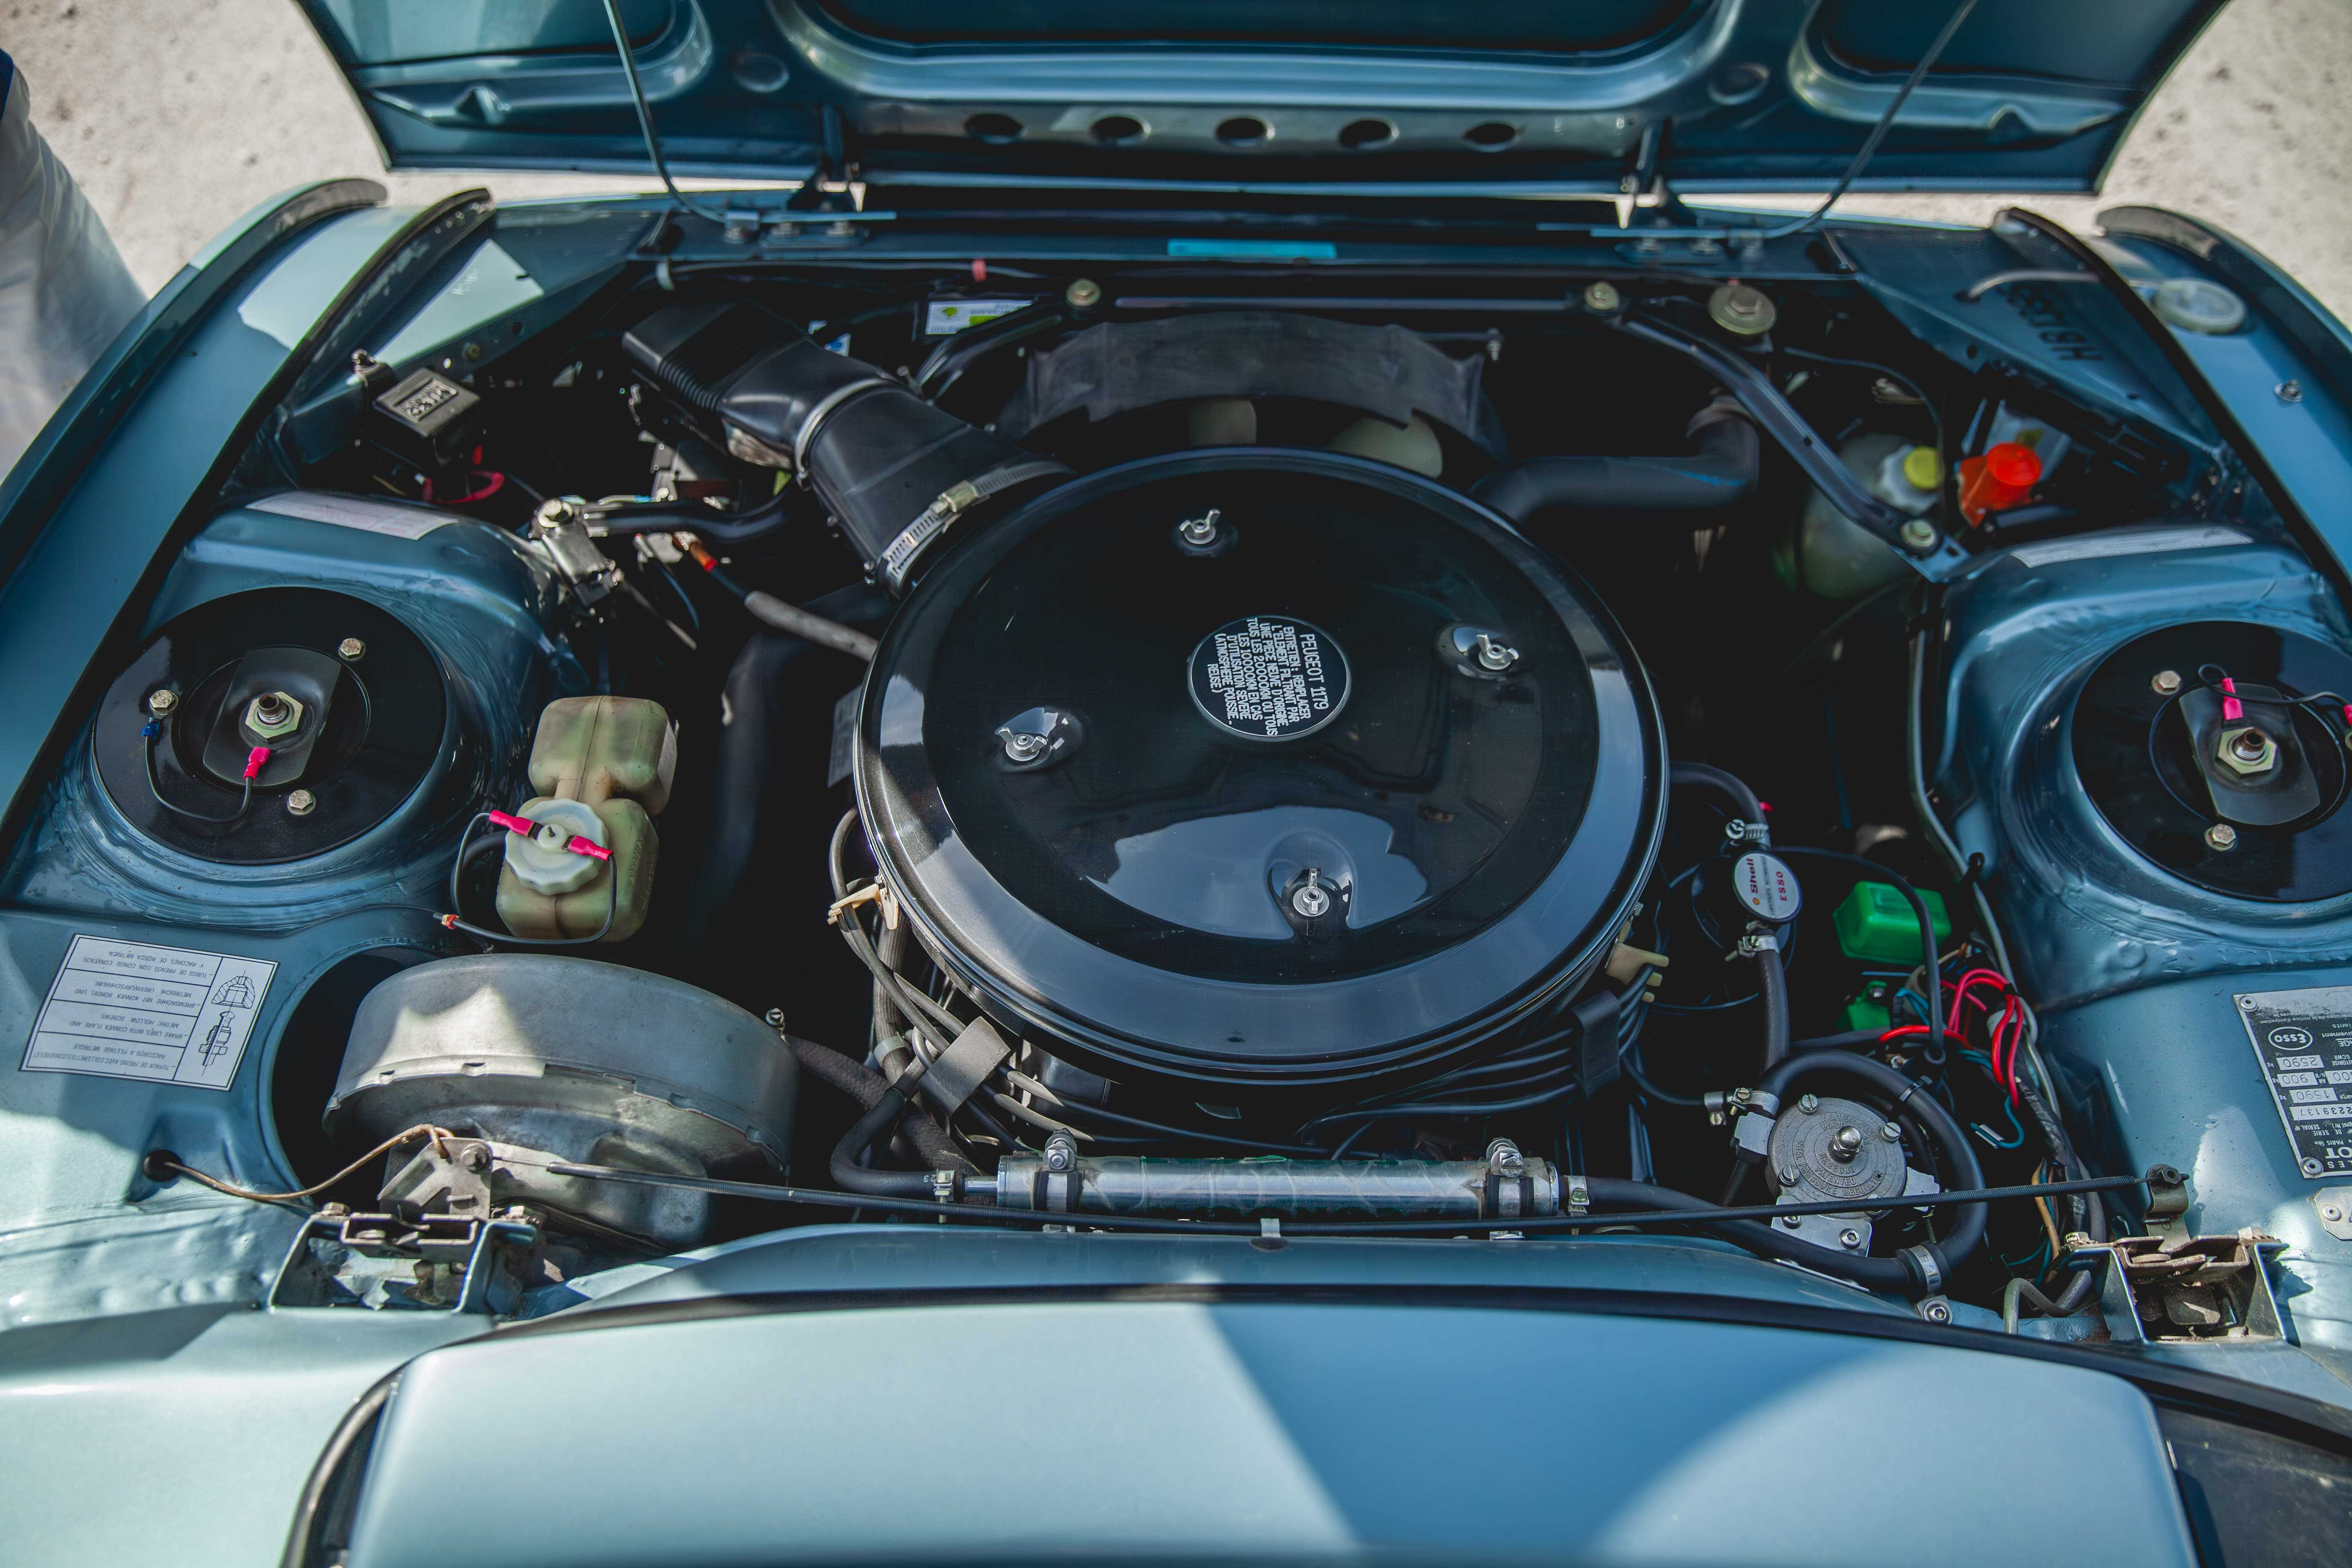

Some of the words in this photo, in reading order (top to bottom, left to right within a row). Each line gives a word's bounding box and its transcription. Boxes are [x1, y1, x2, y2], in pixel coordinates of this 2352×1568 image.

[1246, 617, 1260, 637] TOUS
[1259, 622, 1272, 639] UNE
[1238, 632, 1250, 647] LES
[1251, 639, 1263, 654] LES
[1271, 625, 1289, 667] L'ELEMENT
[1215, 633, 1233, 686] (ATMOSPHERE
[1227, 635, 1246, 688] D'UTILISATION
[1262, 640, 1277, 662] PIECE
[1300, 633, 1324, 683] PEUGEOT
[1207, 663, 1224, 693] REUSE)
[1240, 649, 1258, 691] 10000KM
[1253, 655, 1272, 699] 20000KM
[1266, 662, 1281, 687] NEUVE
[1283, 626, 1301, 672] ENTRETIEN:
[1292, 674, 1311, 719] REMPLACER
[1248, 691, 1261, 703] EN
[1279, 668, 1297, 704] FILTRANT
[1236, 690, 1251, 720] SEVERE
[1261, 701, 1274, 712] OU
[1271, 689, 1289, 727] D'ORIGINE
[1310, 686, 1329, 709] 1179
[1250, 704, 1263, 720] CAS
[1287, 707, 1300, 723] PAR
[1264, 714, 1278, 736] TOUS
[1746, 858, 1758, 894] Shell
[1775, 871, 1787, 901] ESSO
[83, 957, 113, 966] CONVEXOS
[170, 959, 197, 967] RACORES
[160, 989, 192, 998] METRISCHE
[67, 1054, 104, 1063] COLLERETTES
[2283, 1057, 2318, 1068] 2590
[2282, 1074, 2308, 1084] 900
[2296, 1090, 2331, 1100] 1590
[1821, 1114, 1877, 1140] FILTER-KING
[1794, 1140, 1803, 1160] FUEL
[1799, 1163, 1838, 1195] PRESSURE
[1843, 1170, 1884, 1197] REGULATOR
[1815, 1167, 1856, 1186] PATENTED
